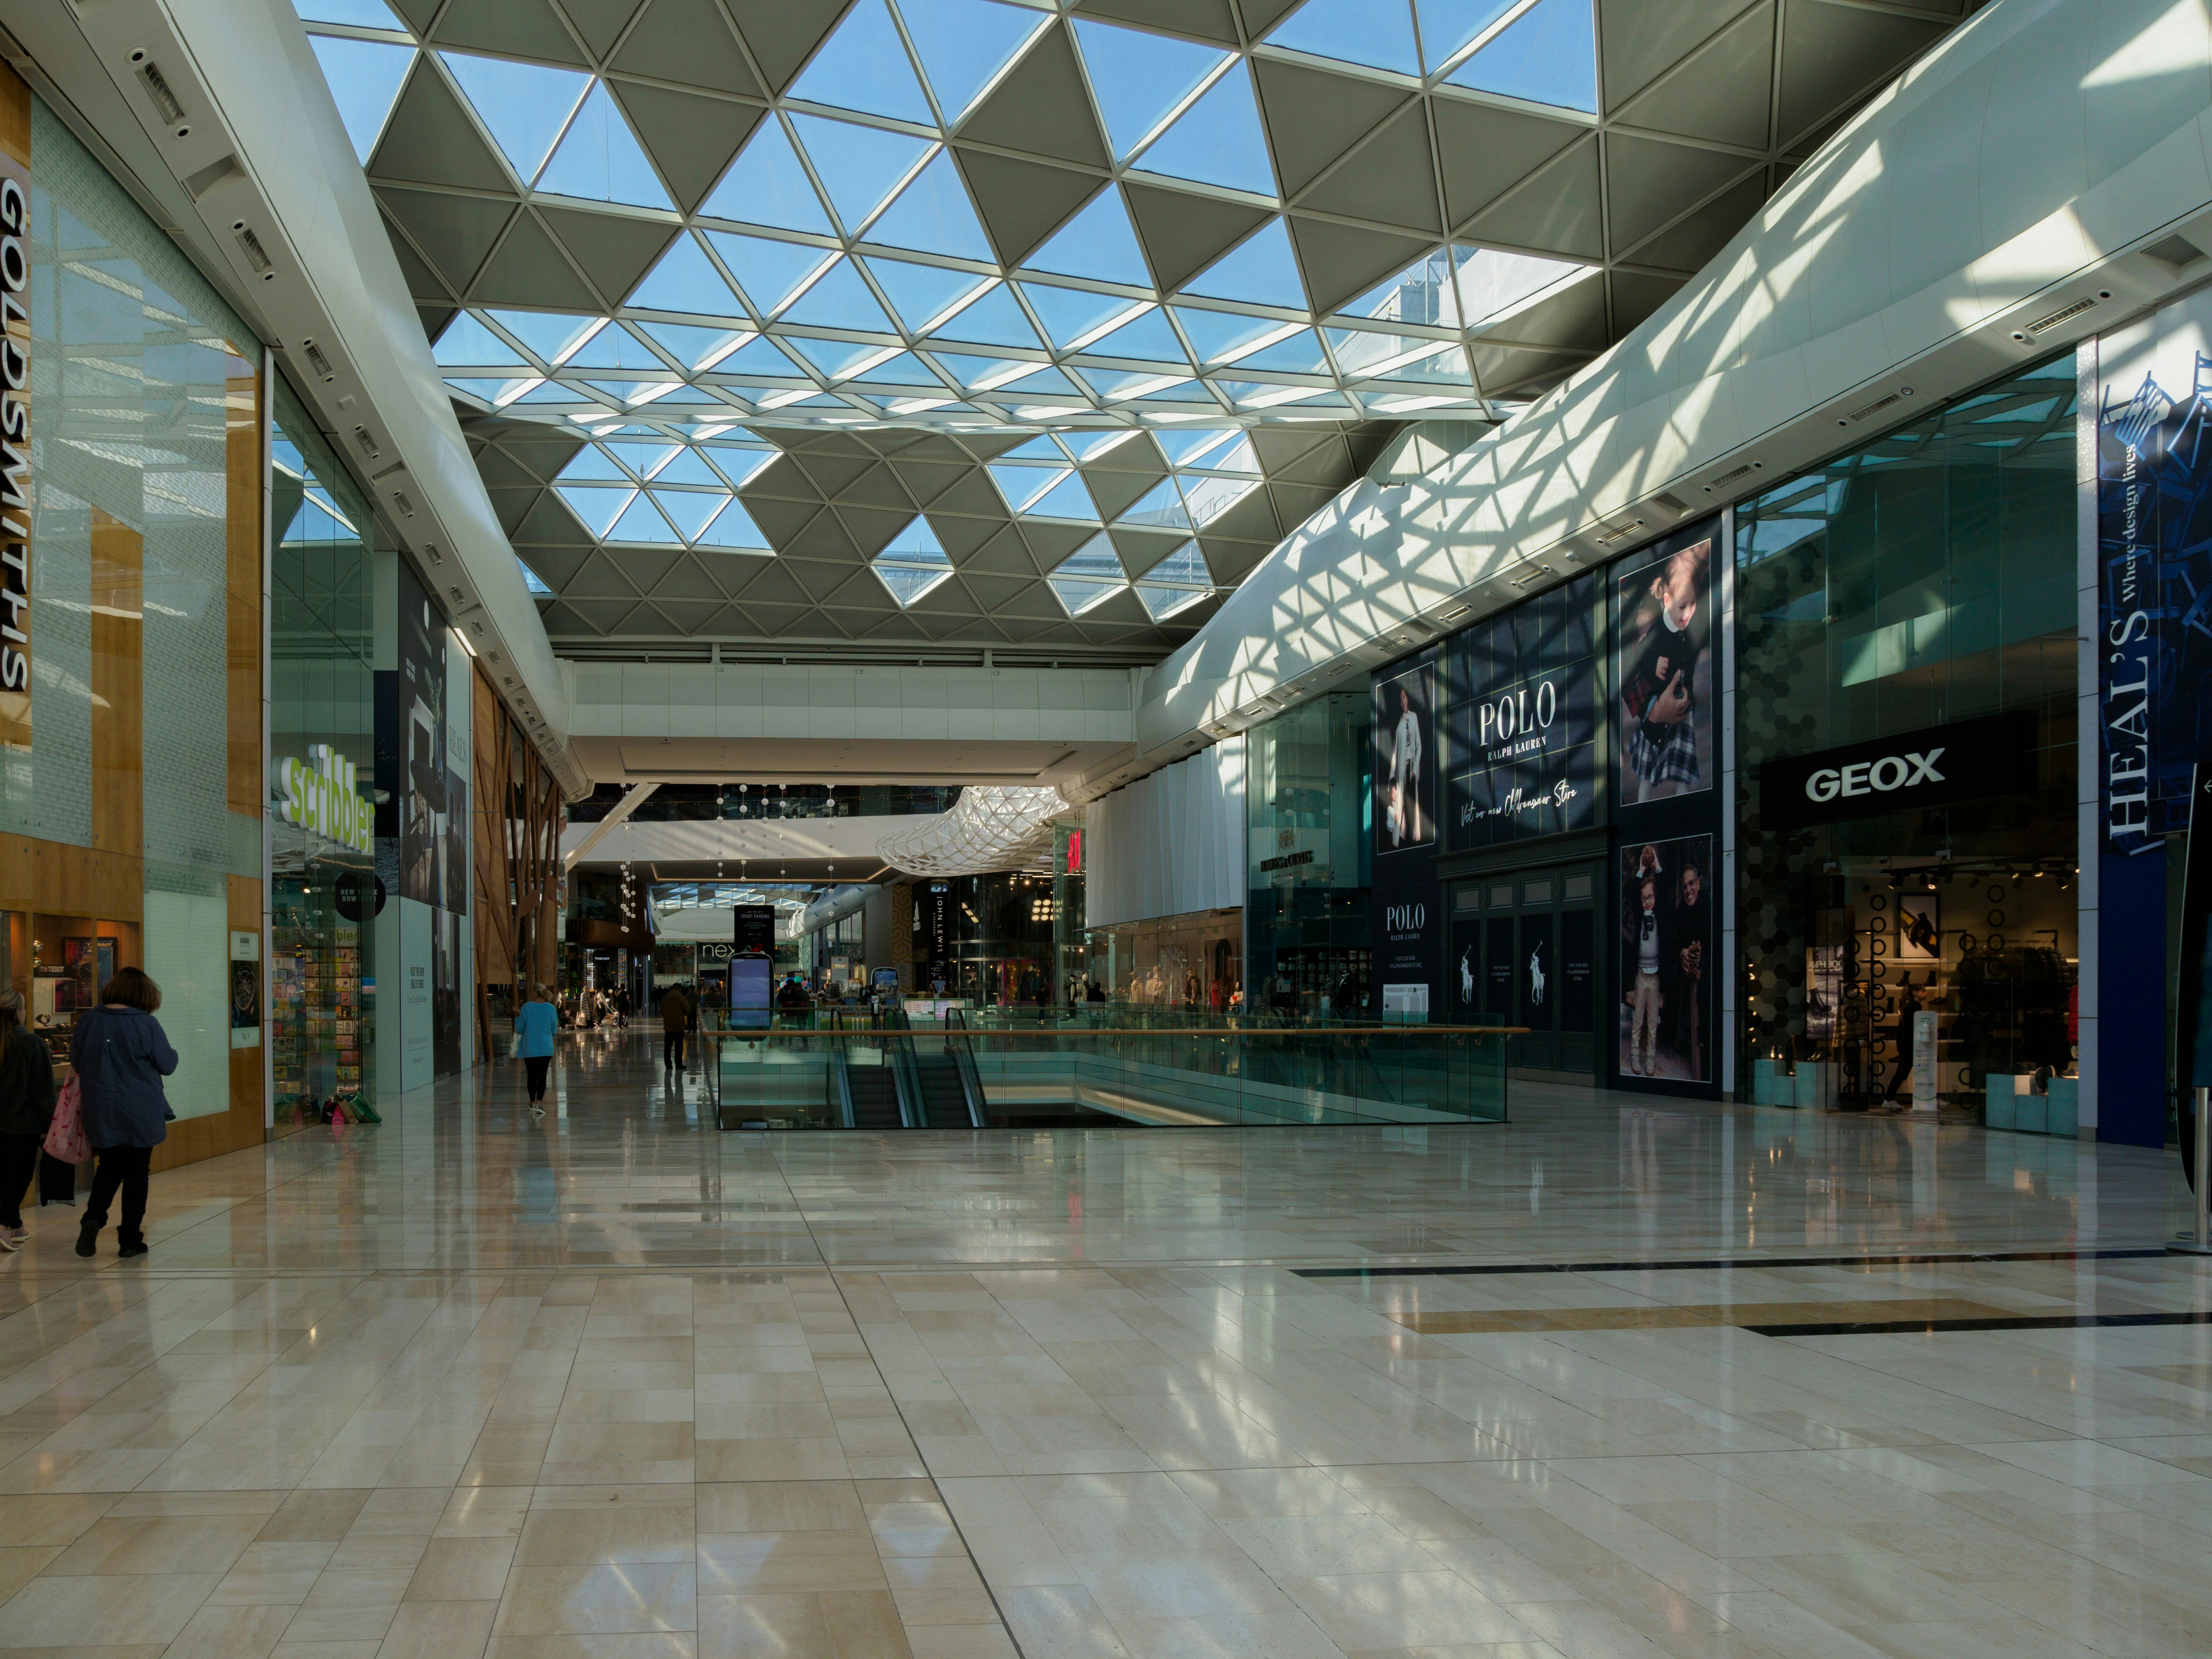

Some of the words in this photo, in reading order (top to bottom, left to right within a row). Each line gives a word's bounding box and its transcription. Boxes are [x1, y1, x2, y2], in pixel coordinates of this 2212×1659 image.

[0, 178, 27, 691] GOLDSMITHS
[2122, 443, 2136, 483] lives
[2122, 485, 2139, 537] design
[2123, 544, 2136, 602] Where
[1479, 681, 1555, 746] POLO
[1488, 746, 1511, 762] RALPH
[1516, 736, 1546, 754] LAUREN
[1805, 748, 1945, 802] GEOX
[280, 744, 375, 853] scribbler
[1461, 800, 1476, 827] Visit
[1488, 806, 1501, 815] new
[1505, 788, 1551, 816] Childrenswear
[1554, 778, 1578, 807] Store
[1386, 903, 1424, 931] POLO
[703, 944, 735, 958] nex
